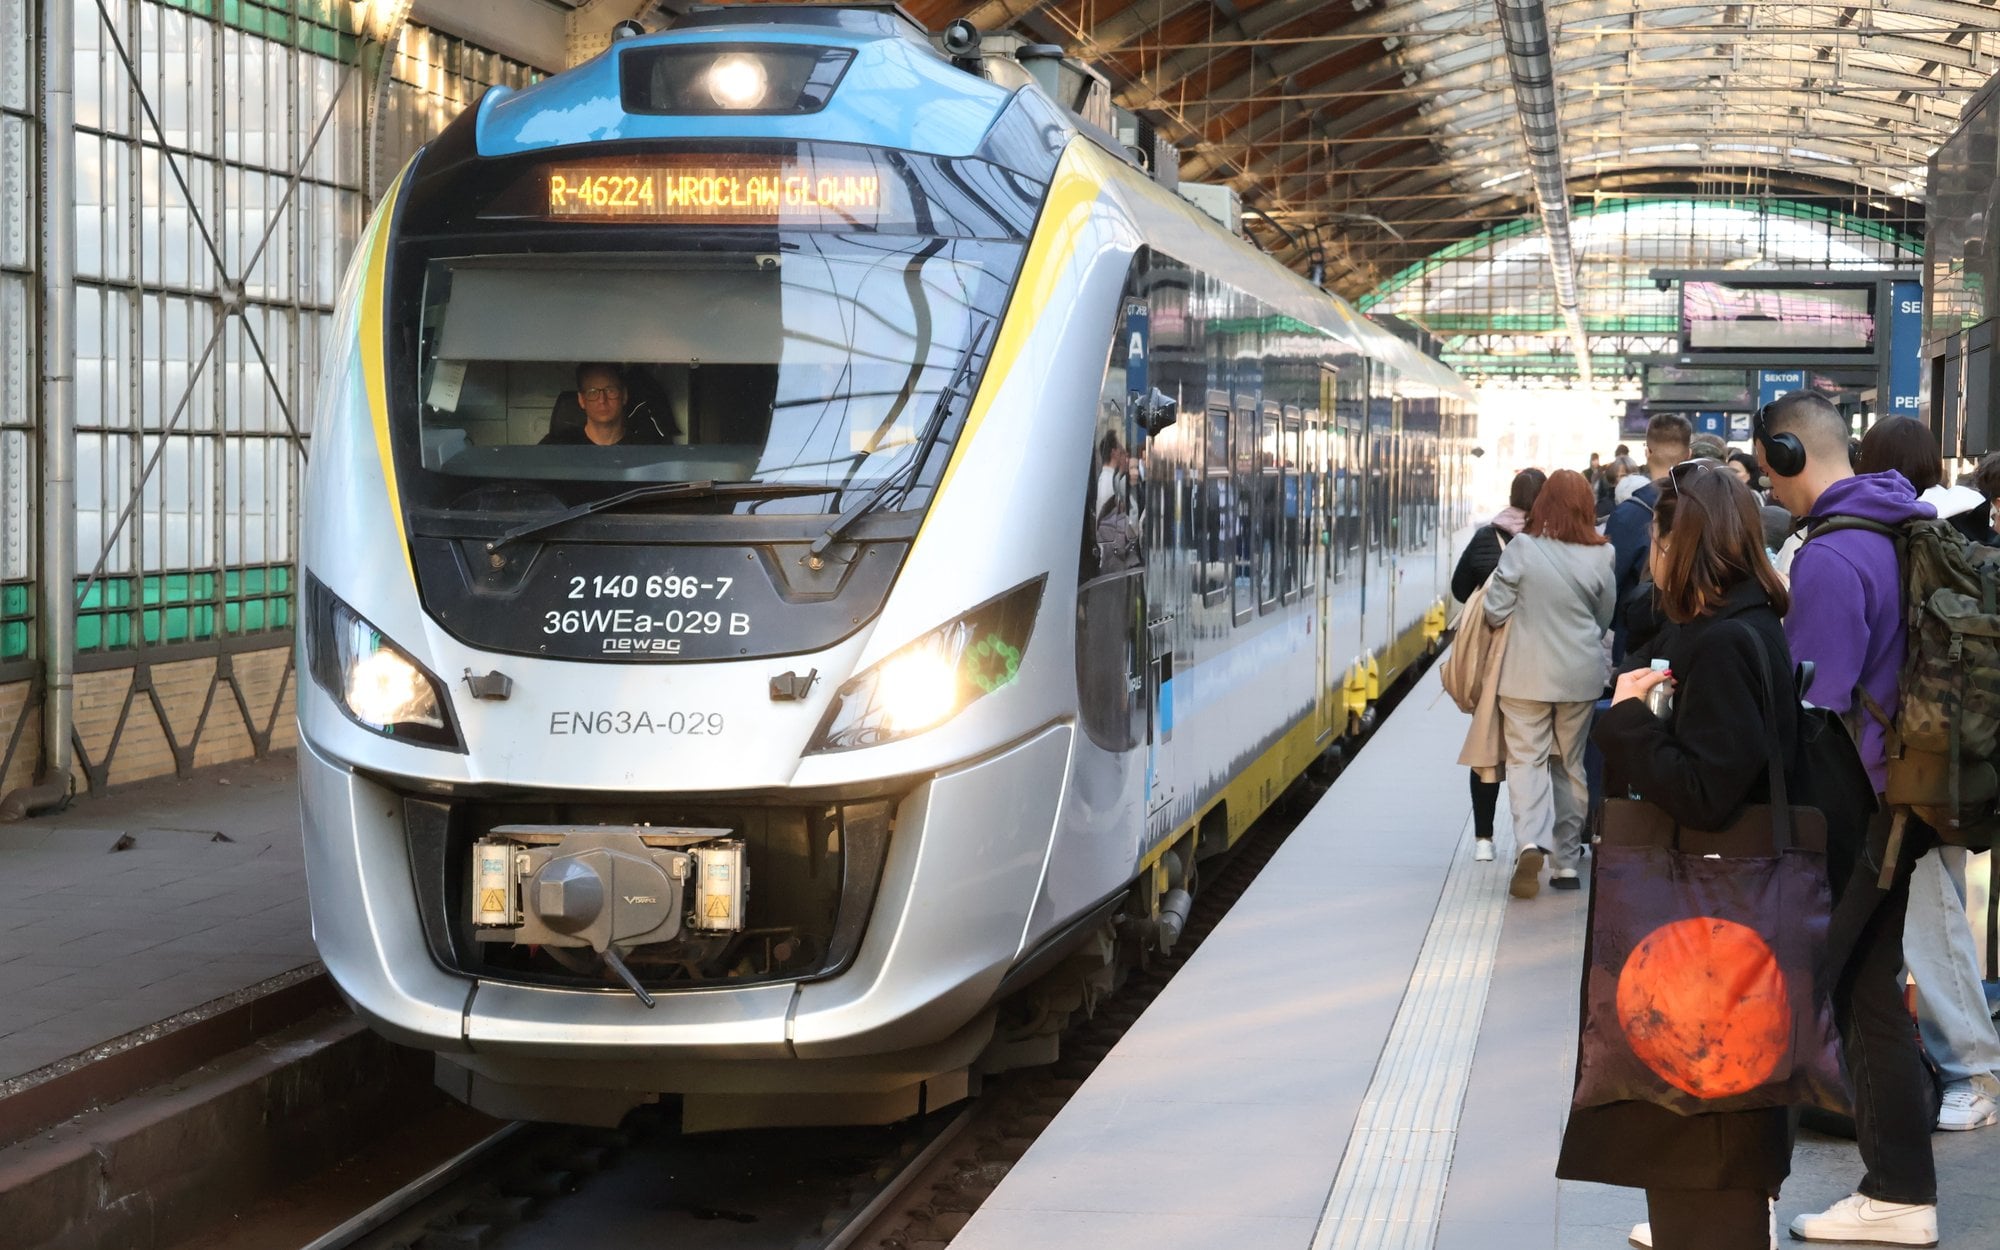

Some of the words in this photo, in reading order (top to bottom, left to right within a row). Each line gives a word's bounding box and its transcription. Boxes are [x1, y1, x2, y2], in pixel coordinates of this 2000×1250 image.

[551, 176, 654, 206] R-46224
[666, 176, 780, 206] WROCŁAW
[1764, 374, 1799, 382] SEKTOR
[568, 576, 586, 599] 2
[593, 575, 638, 599] 140
[645, 575, 733, 600] 696-7
[543, 609, 722, 635] 36WEa-029
[729, 612, 750, 636] B
[602, 638, 681, 651] newag
[549, 710, 725, 736] EN63A-029
